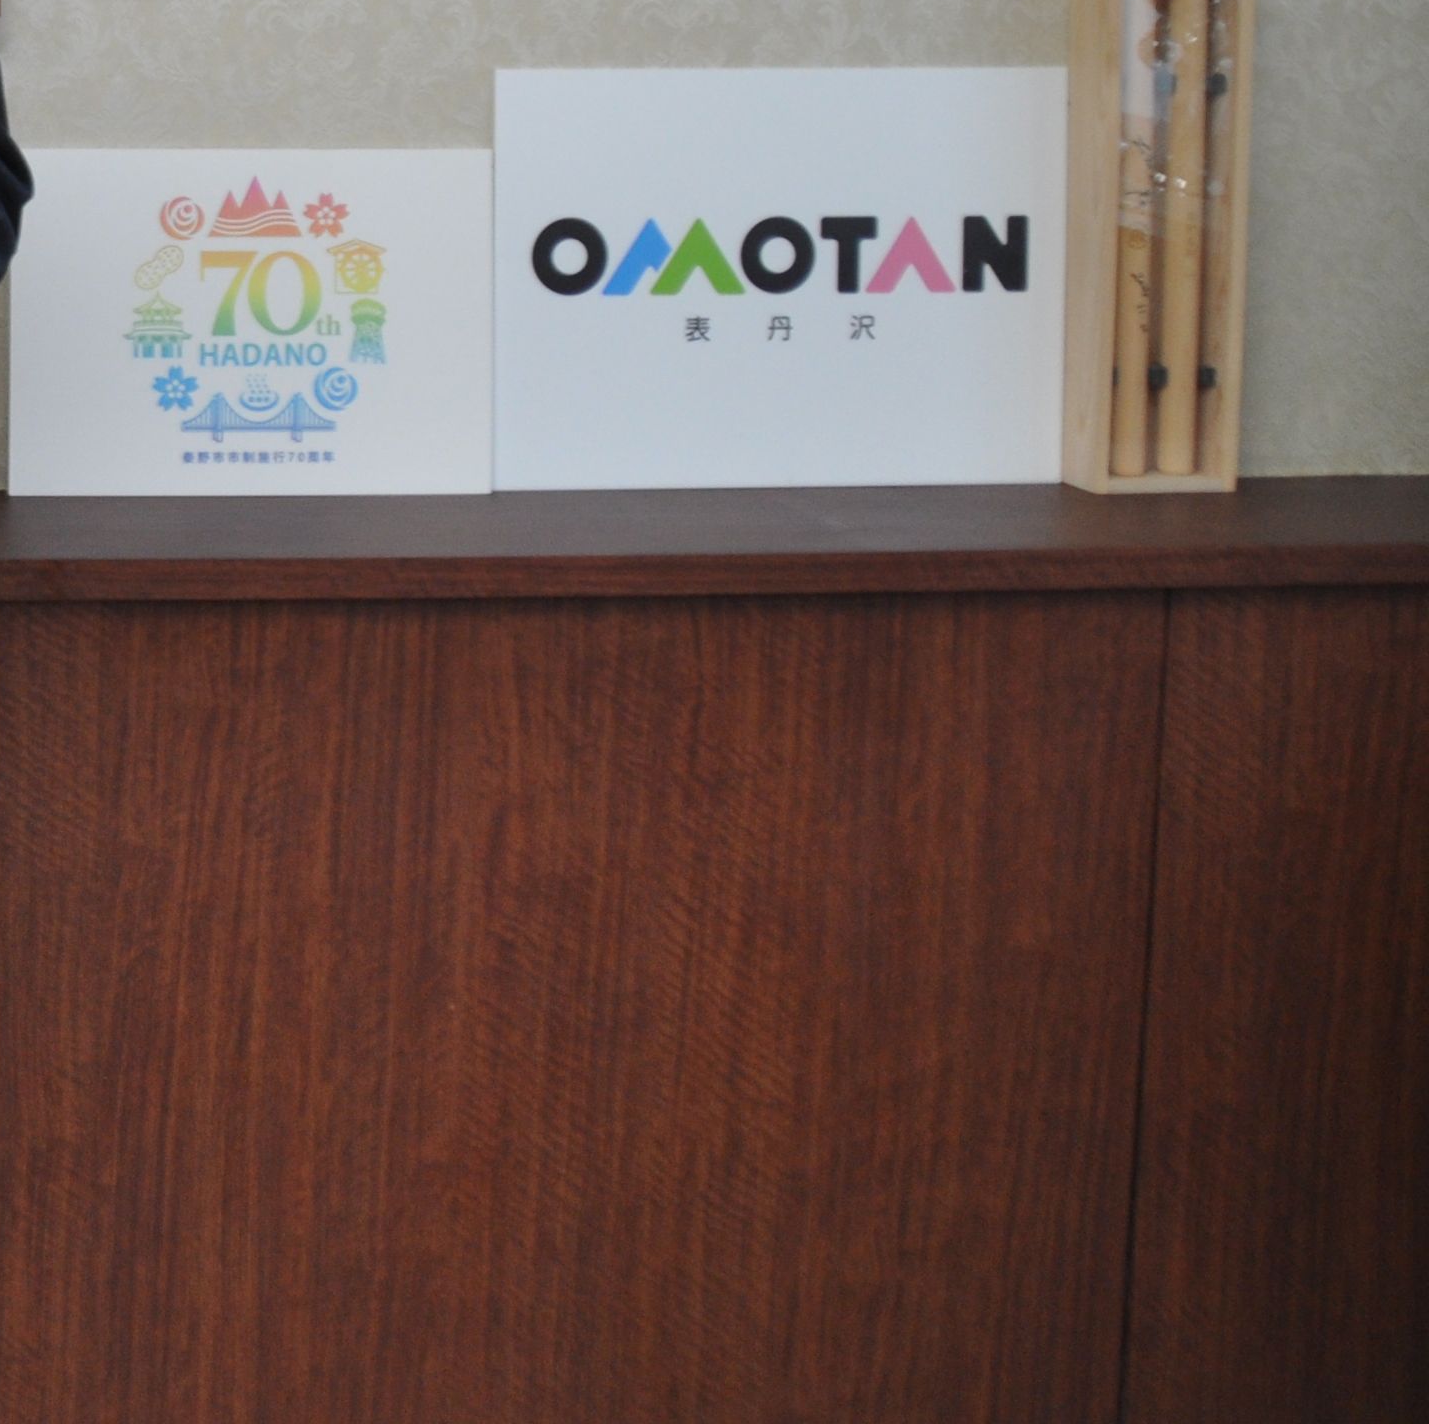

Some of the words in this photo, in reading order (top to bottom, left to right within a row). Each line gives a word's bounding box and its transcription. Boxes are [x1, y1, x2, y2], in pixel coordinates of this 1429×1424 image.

[531, 214, 1030, 296] OMOTAN
[684, 315, 877, 342] 表丹沢
[199, 343, 328, 367] HADANO
